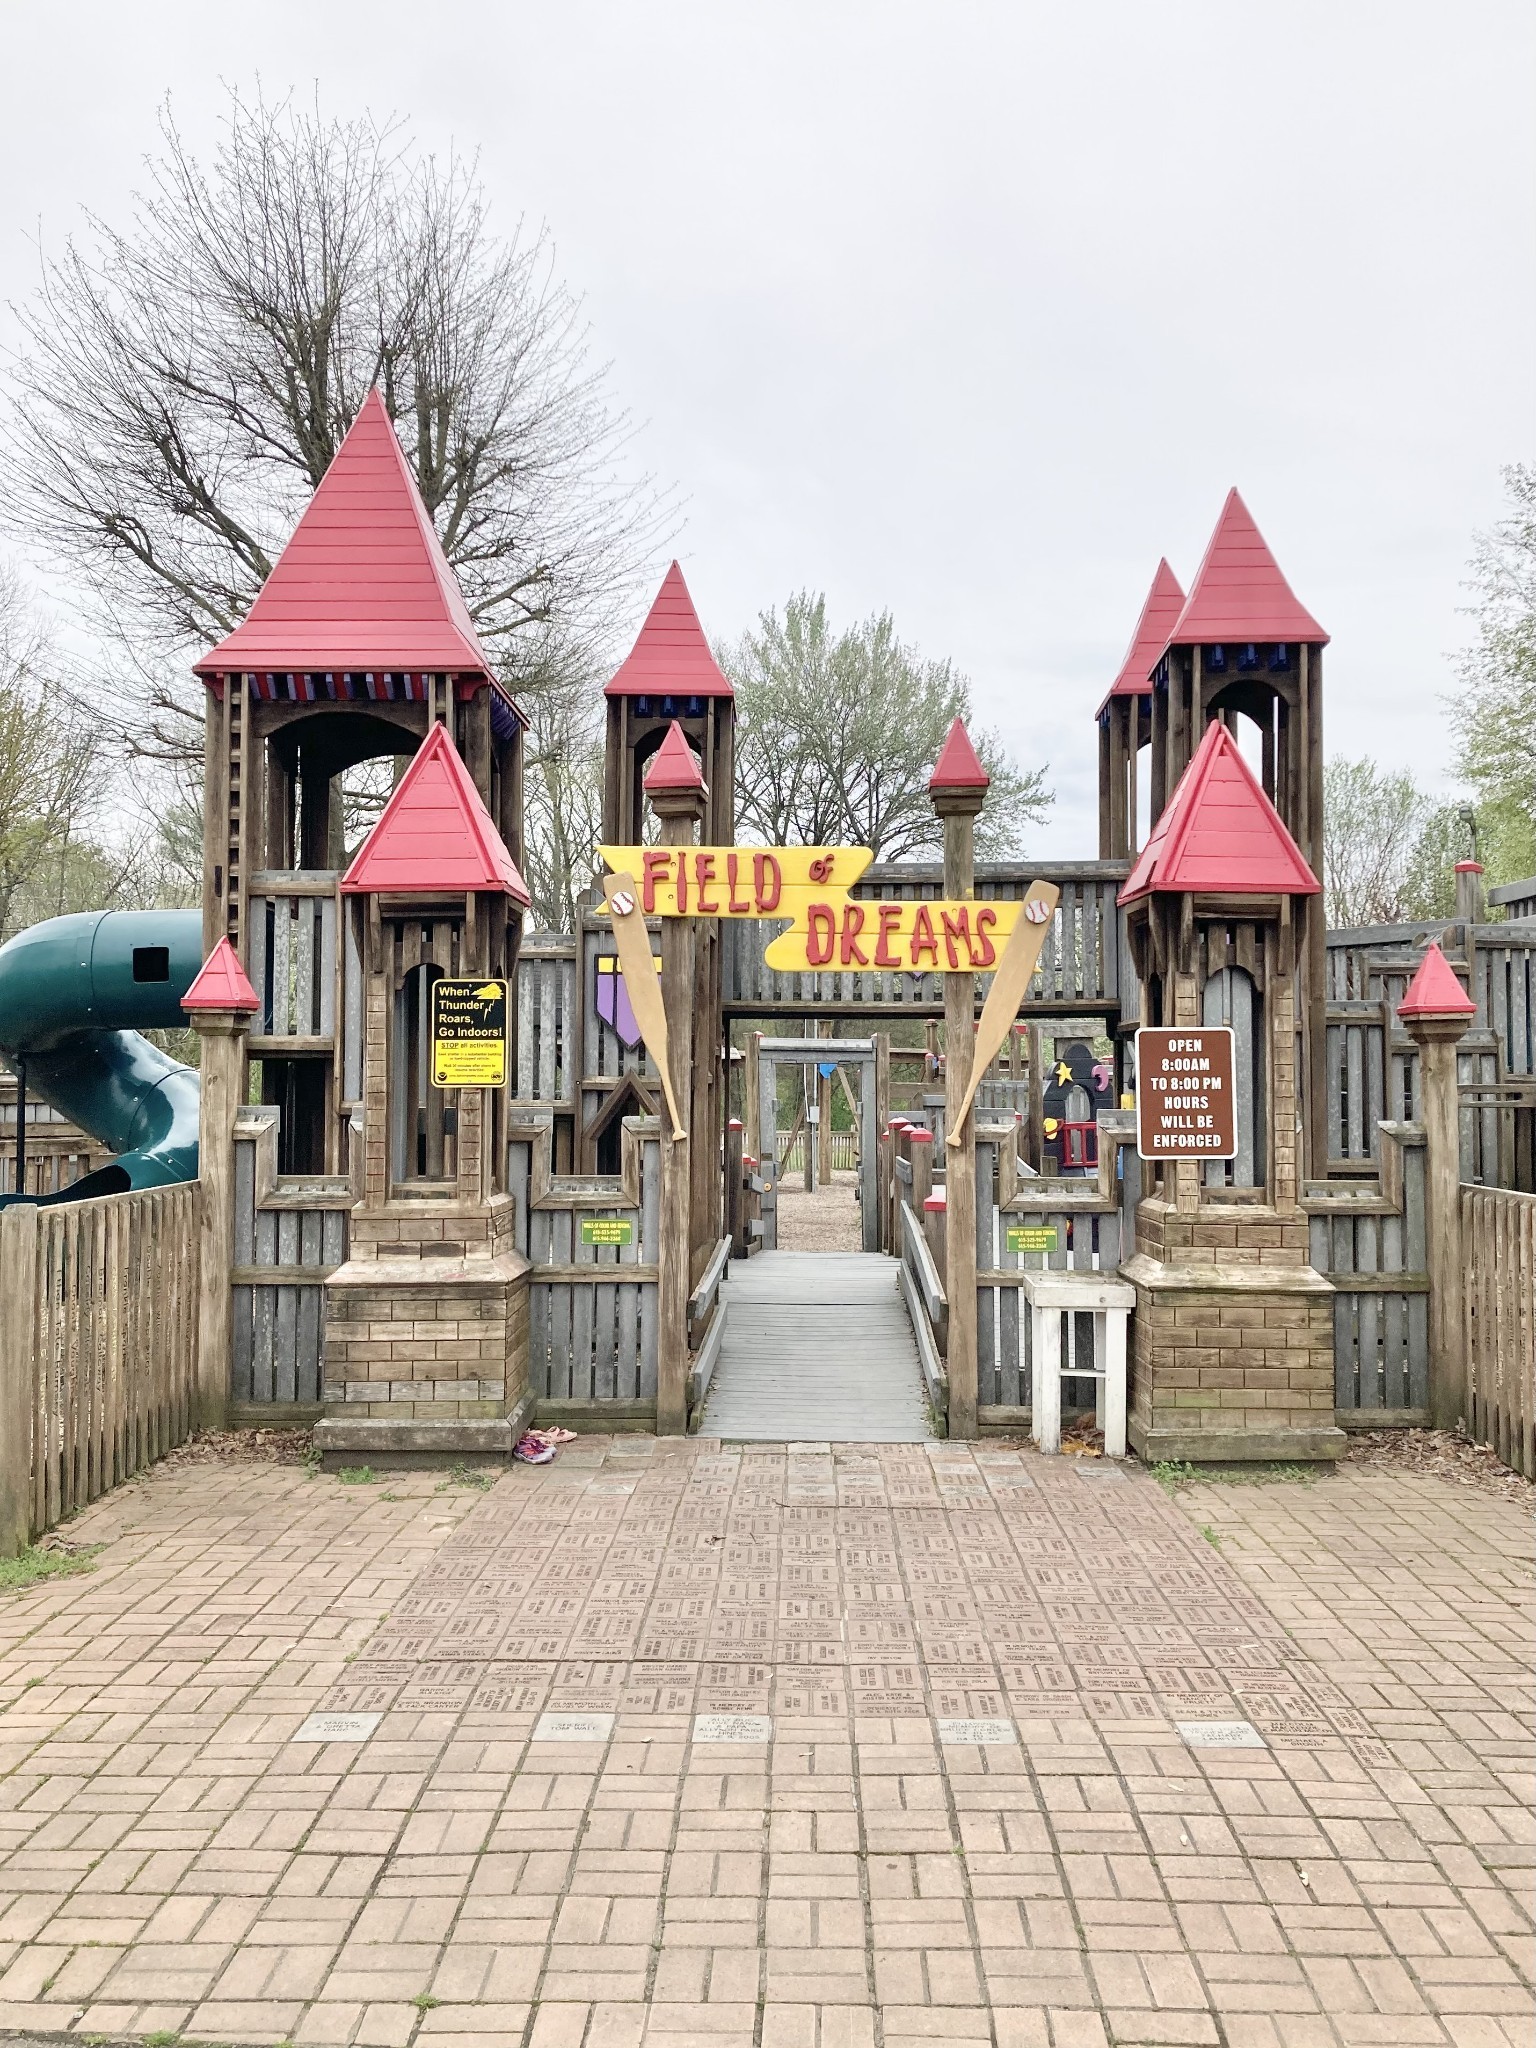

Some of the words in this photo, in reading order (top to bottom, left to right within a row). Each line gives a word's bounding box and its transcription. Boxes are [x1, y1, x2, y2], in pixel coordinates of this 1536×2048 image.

[643, 851, 781, 913] FIELD
[806, 903, 997, 969] DREAMS
[438, 986, 470, 996] When
[439, 1000, 485, 1010] Thunder
[439, 1013, 474, 1025] Roars,
[438, 1027, 454, 1037] Go
[457, 1027, 502, 1037] Indoors!
[1168, 1039, 1202, 1052] OPEN
[1161, 1058, 1210, 1071] 8:00AM
[1150, 1077, 1168, 1091] TO
[1170, 1077, 1200, 1090] 8:00
[1203, 1077, 1222, 1090] PM
[1164, 1096, 1209, 1109] HOURS
[1160, 1115, 1194, 1128] WILL
[1197, 1115, 1214, 1128] BE
[1153, 1134, 1222, 1148] ENFORCED
